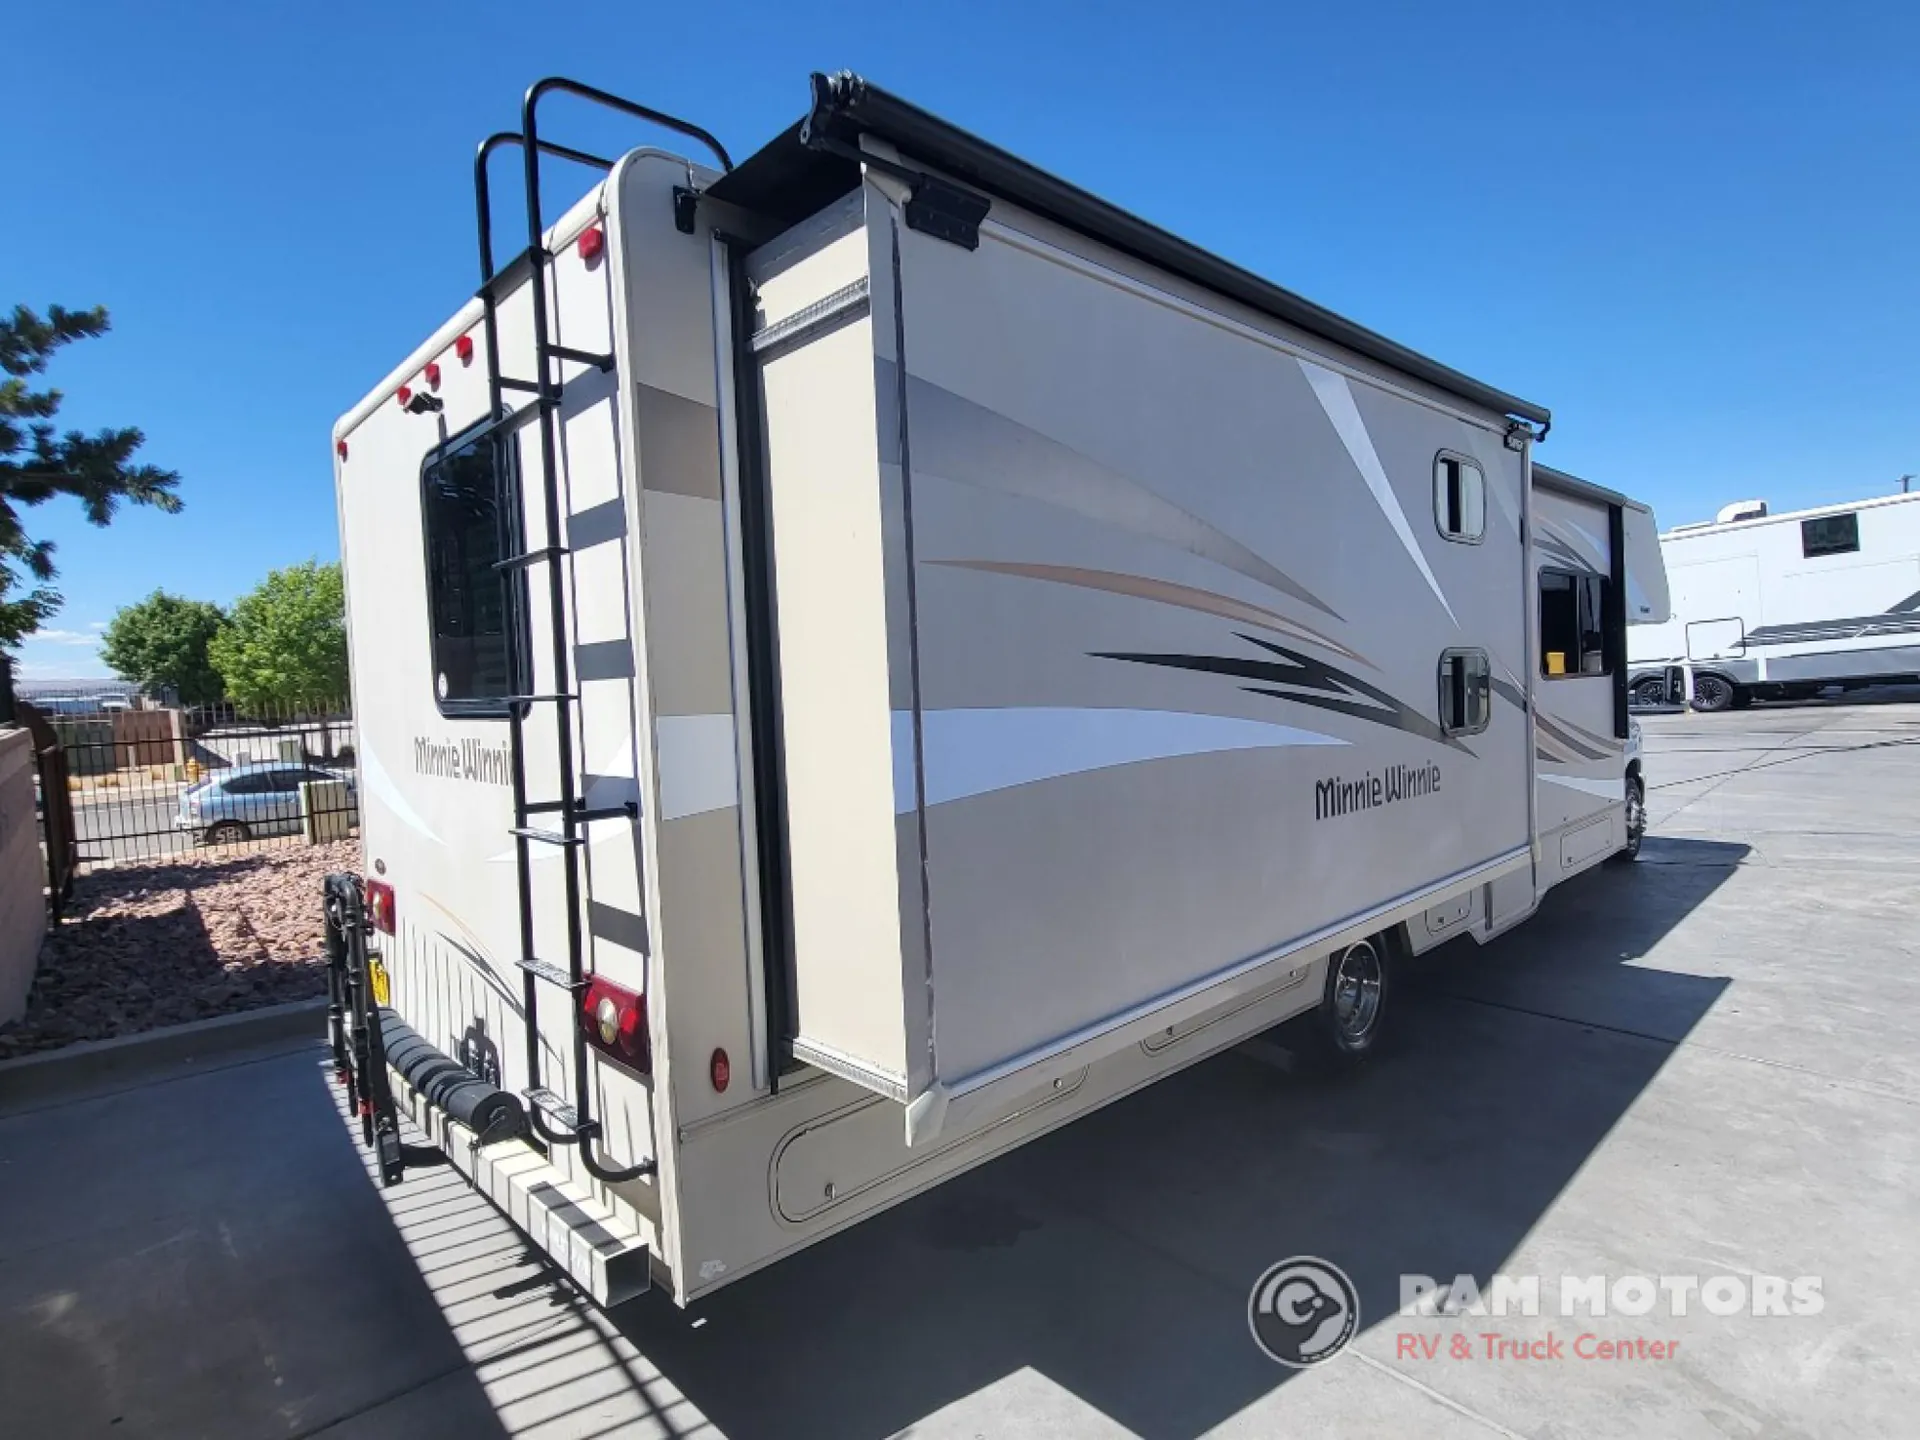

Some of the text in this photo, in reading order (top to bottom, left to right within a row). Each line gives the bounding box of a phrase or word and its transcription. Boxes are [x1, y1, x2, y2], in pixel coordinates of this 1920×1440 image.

[414, 736, 460, 779] Minnie
[1315, 759, 1441, 821] Minnie Winnie
